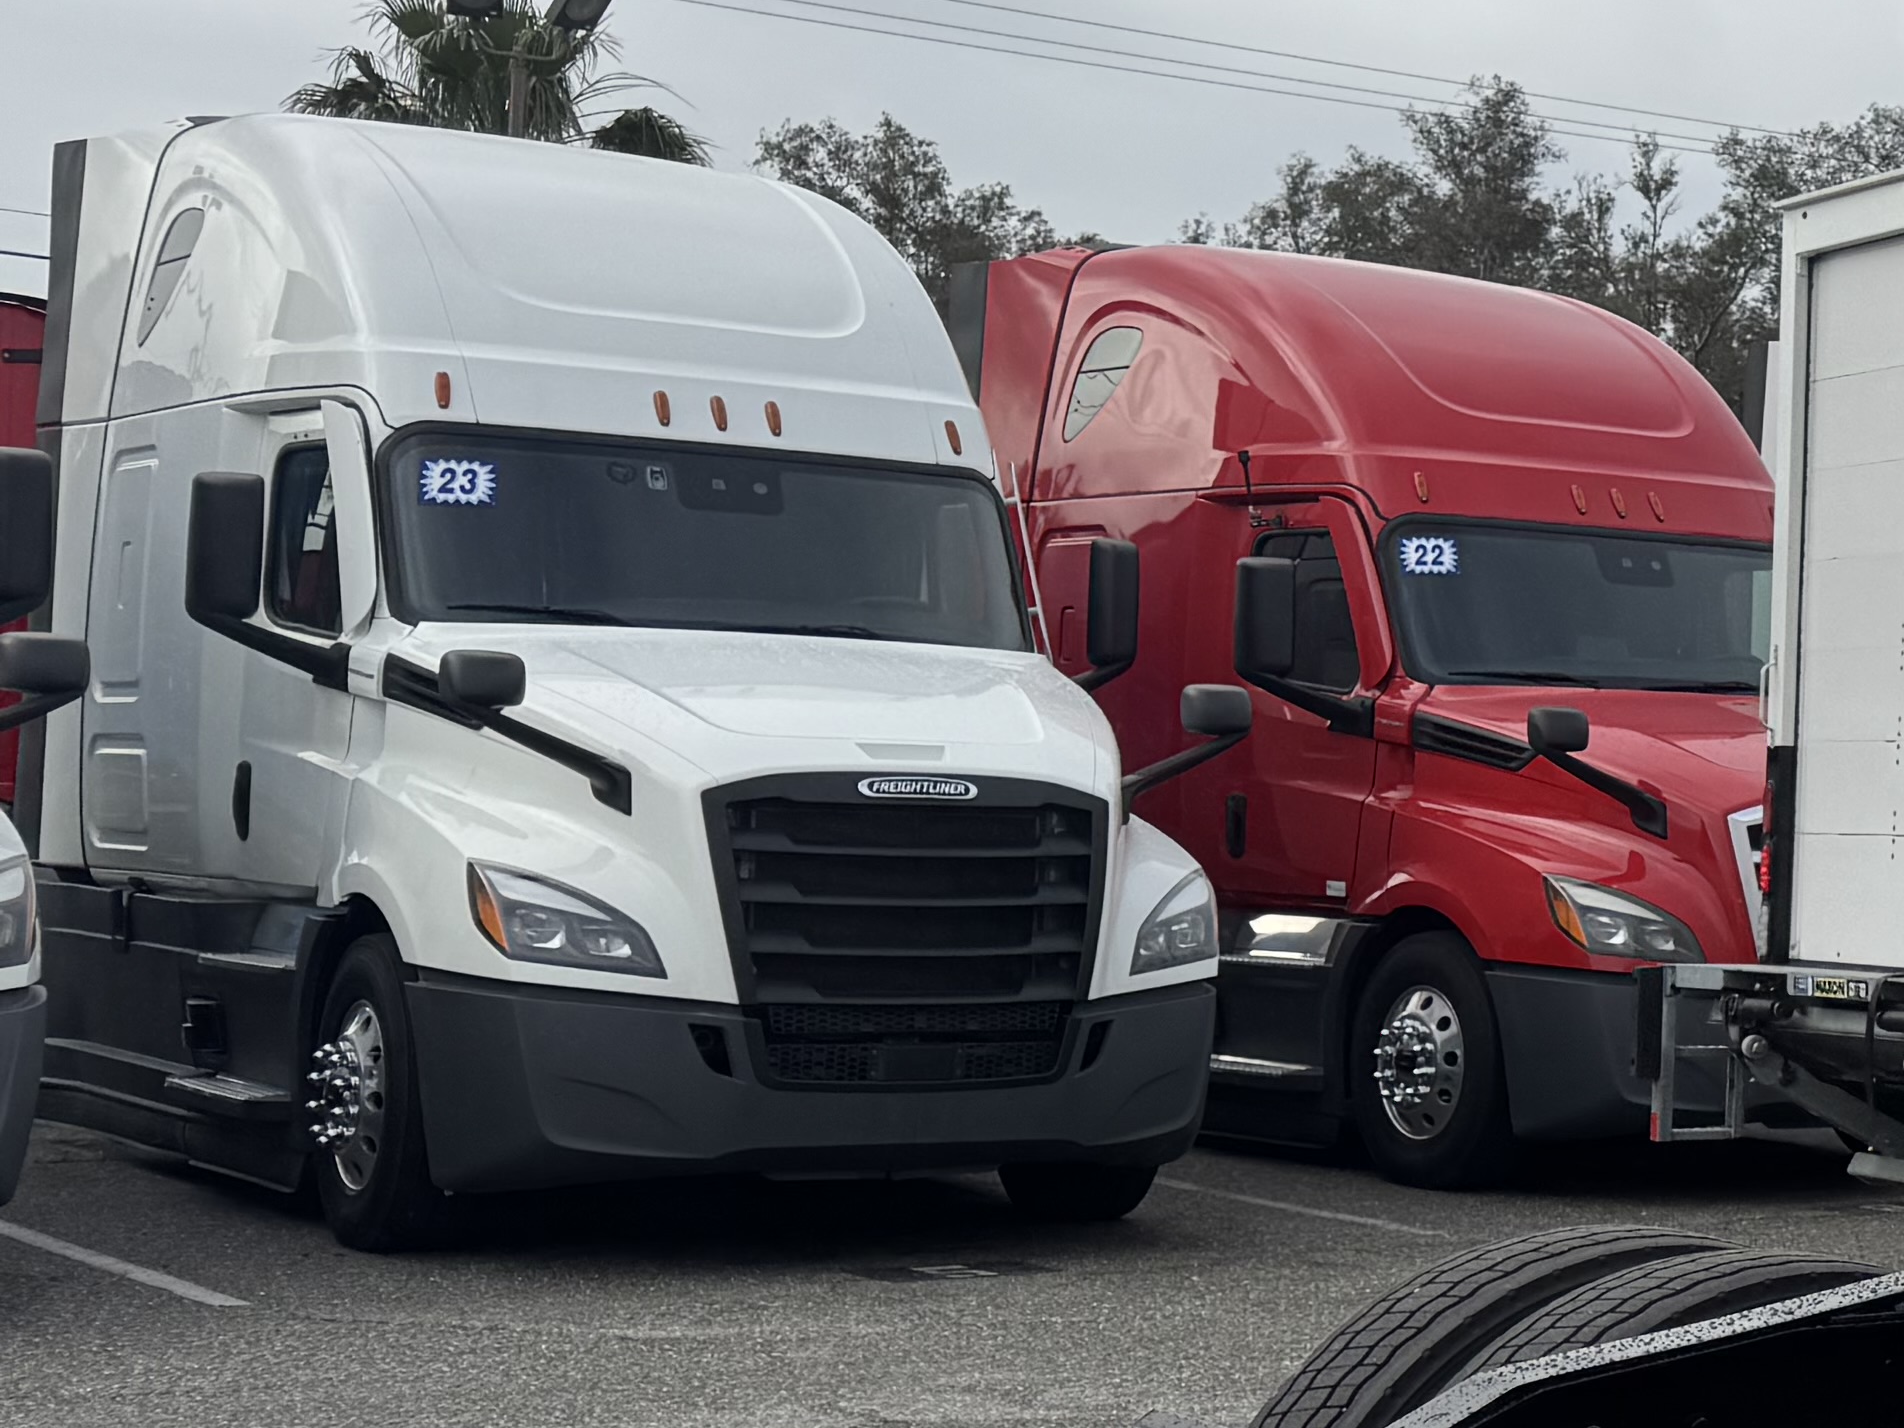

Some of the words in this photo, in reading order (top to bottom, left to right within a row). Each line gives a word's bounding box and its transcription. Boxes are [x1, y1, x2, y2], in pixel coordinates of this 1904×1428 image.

[437, 467, 478, 495] 23
[1414, 543, 1445, 566] 22
[872, 780, 966, 795] FREIGHTLINER
